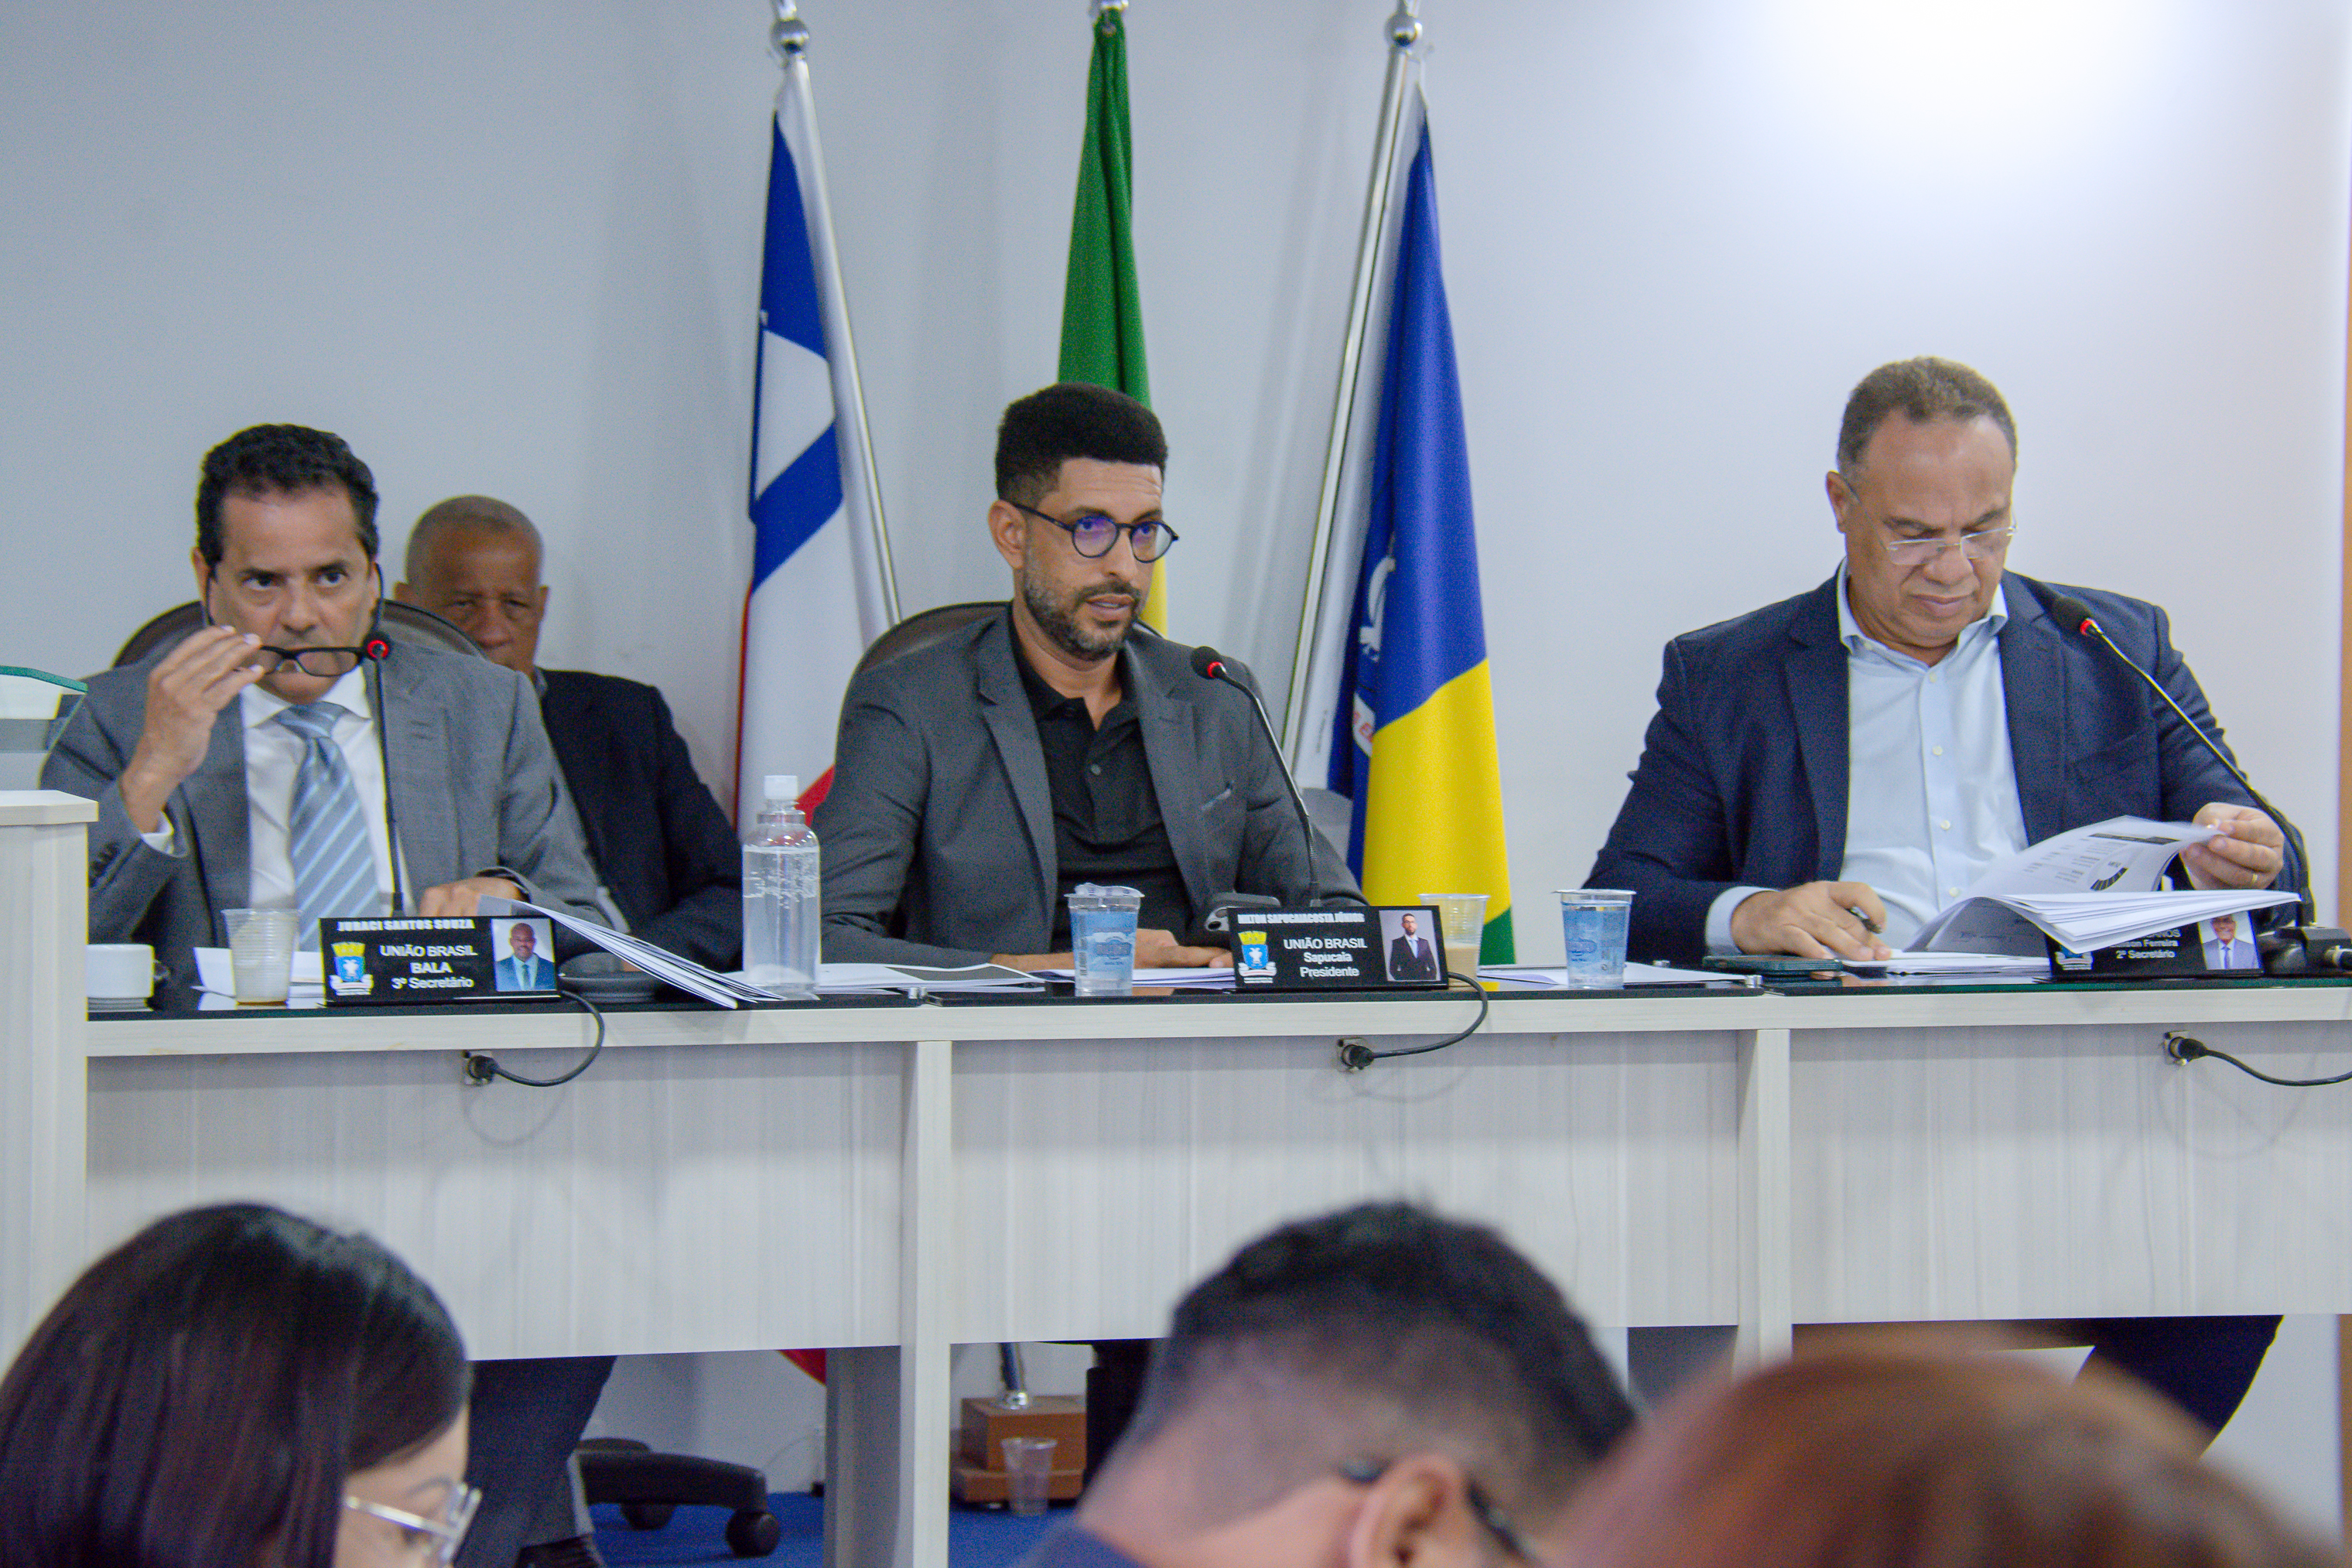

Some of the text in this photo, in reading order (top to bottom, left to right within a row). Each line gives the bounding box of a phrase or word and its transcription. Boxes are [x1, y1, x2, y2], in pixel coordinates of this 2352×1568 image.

[337, 918, 476, 931] JURACI SANTOS SOUZA
[1284, 937, 1368, 950] UNIÃO BRASIL
[379, 944, 478, 958] UNIÃO BRASIL
[1303, 951, 1353, 964] Sapucaia
[2128, 949, 2176, 959] Secretário
[409, 962, 453, 975] BALA
[1300, 966, 1360, 978] Presidente
[408, 975, 475, 989] Secretário
